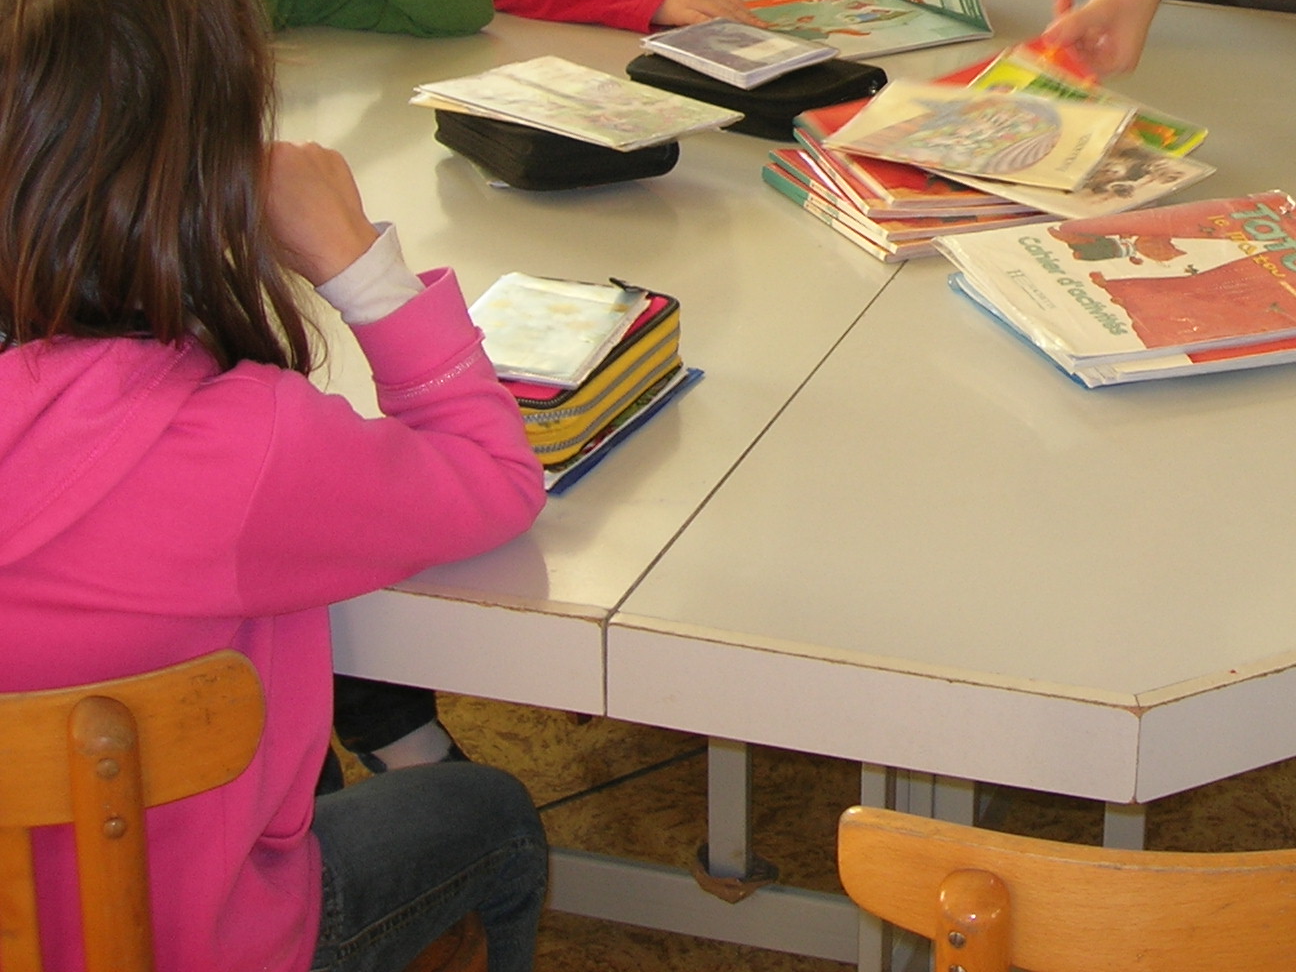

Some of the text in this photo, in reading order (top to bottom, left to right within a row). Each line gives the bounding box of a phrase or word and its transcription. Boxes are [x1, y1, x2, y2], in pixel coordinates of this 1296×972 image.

[1207, 214, 1231, 227] le
[1018, 236, 1128, 336] Cahier d'activités
